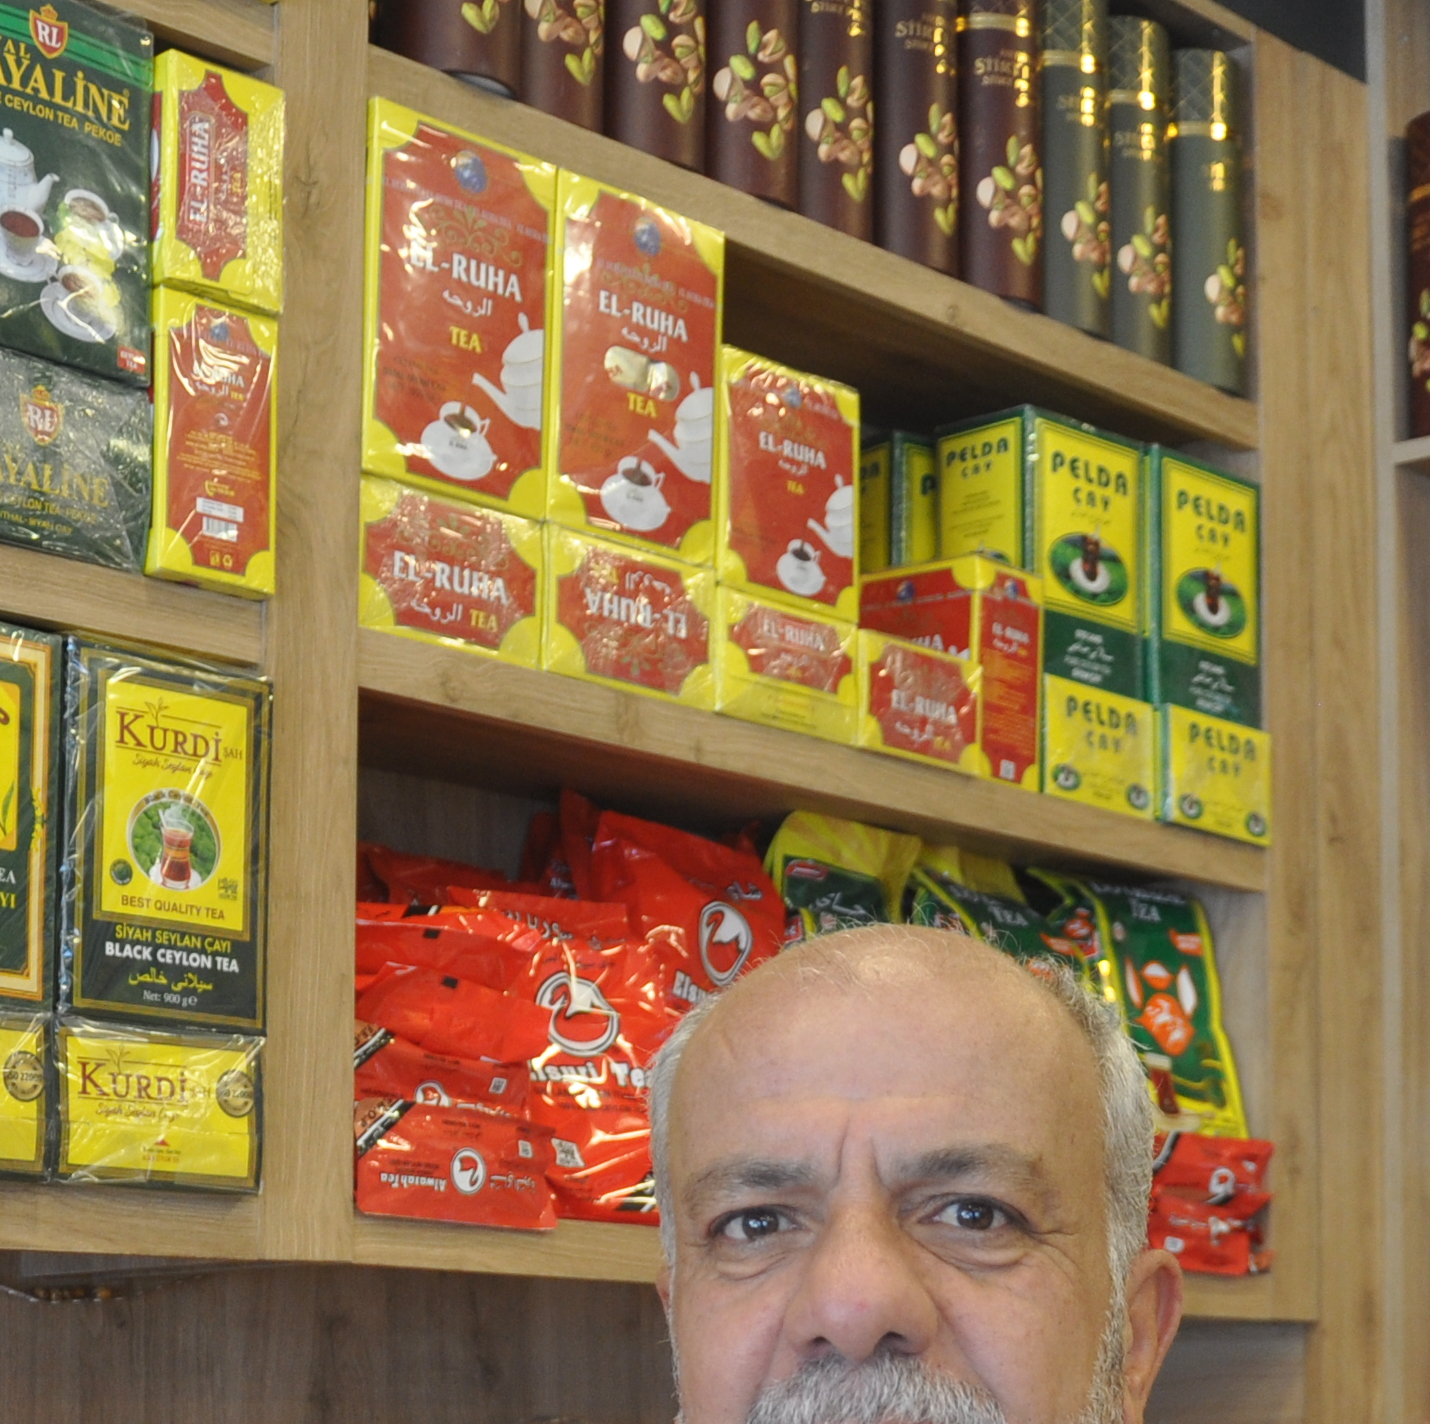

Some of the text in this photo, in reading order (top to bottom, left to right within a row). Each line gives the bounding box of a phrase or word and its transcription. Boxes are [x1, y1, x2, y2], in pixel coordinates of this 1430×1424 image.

[36, 20, 62, 49] RL
[5, 92, 55, 120] CEYLON
[56, 111, 79, 129] TEA
[84, 121, 122, 147] PEKOE
[189, 117, 211, 224] EL-RUHA
[598, 290, 689, 342] EL-RUHA
[449, 326, 482, 354] TEA
[626, 391, 657, 418] TEA
[759, 431, 826, 469] EL-RUHA
[946, 435, 1009, 467] PELDA
[786, 480, 804, 496] TEA
[1051, 450, 1129, 497] PELDA
[1176, 488, 1247, 534] PELDA
[392, 551, 509, 605] EL-RUHA
[470, 608, 498, 633] TEA
[585, 587, 688, 640] EL-RUHA
[763, 612, 825, 651] EL-RUHA
[891, 689, 958, 724] EL-RUHA
[1066, 694, 1138, 737] PELDA
[223, 747, 243, 760] ŞAH
[1189, 722, 1257, 763] PELDA
[121, 893, 225, 921] BEST QUALITY TEA
[115, 923, 232, 954] SİYAH SEYLAN ÇAYI
[105, 941, 240, 973] BLACK CEYLON TEA
[143, 990, 161, 1002] Net:
[163, 992, 180, 1005] 900
